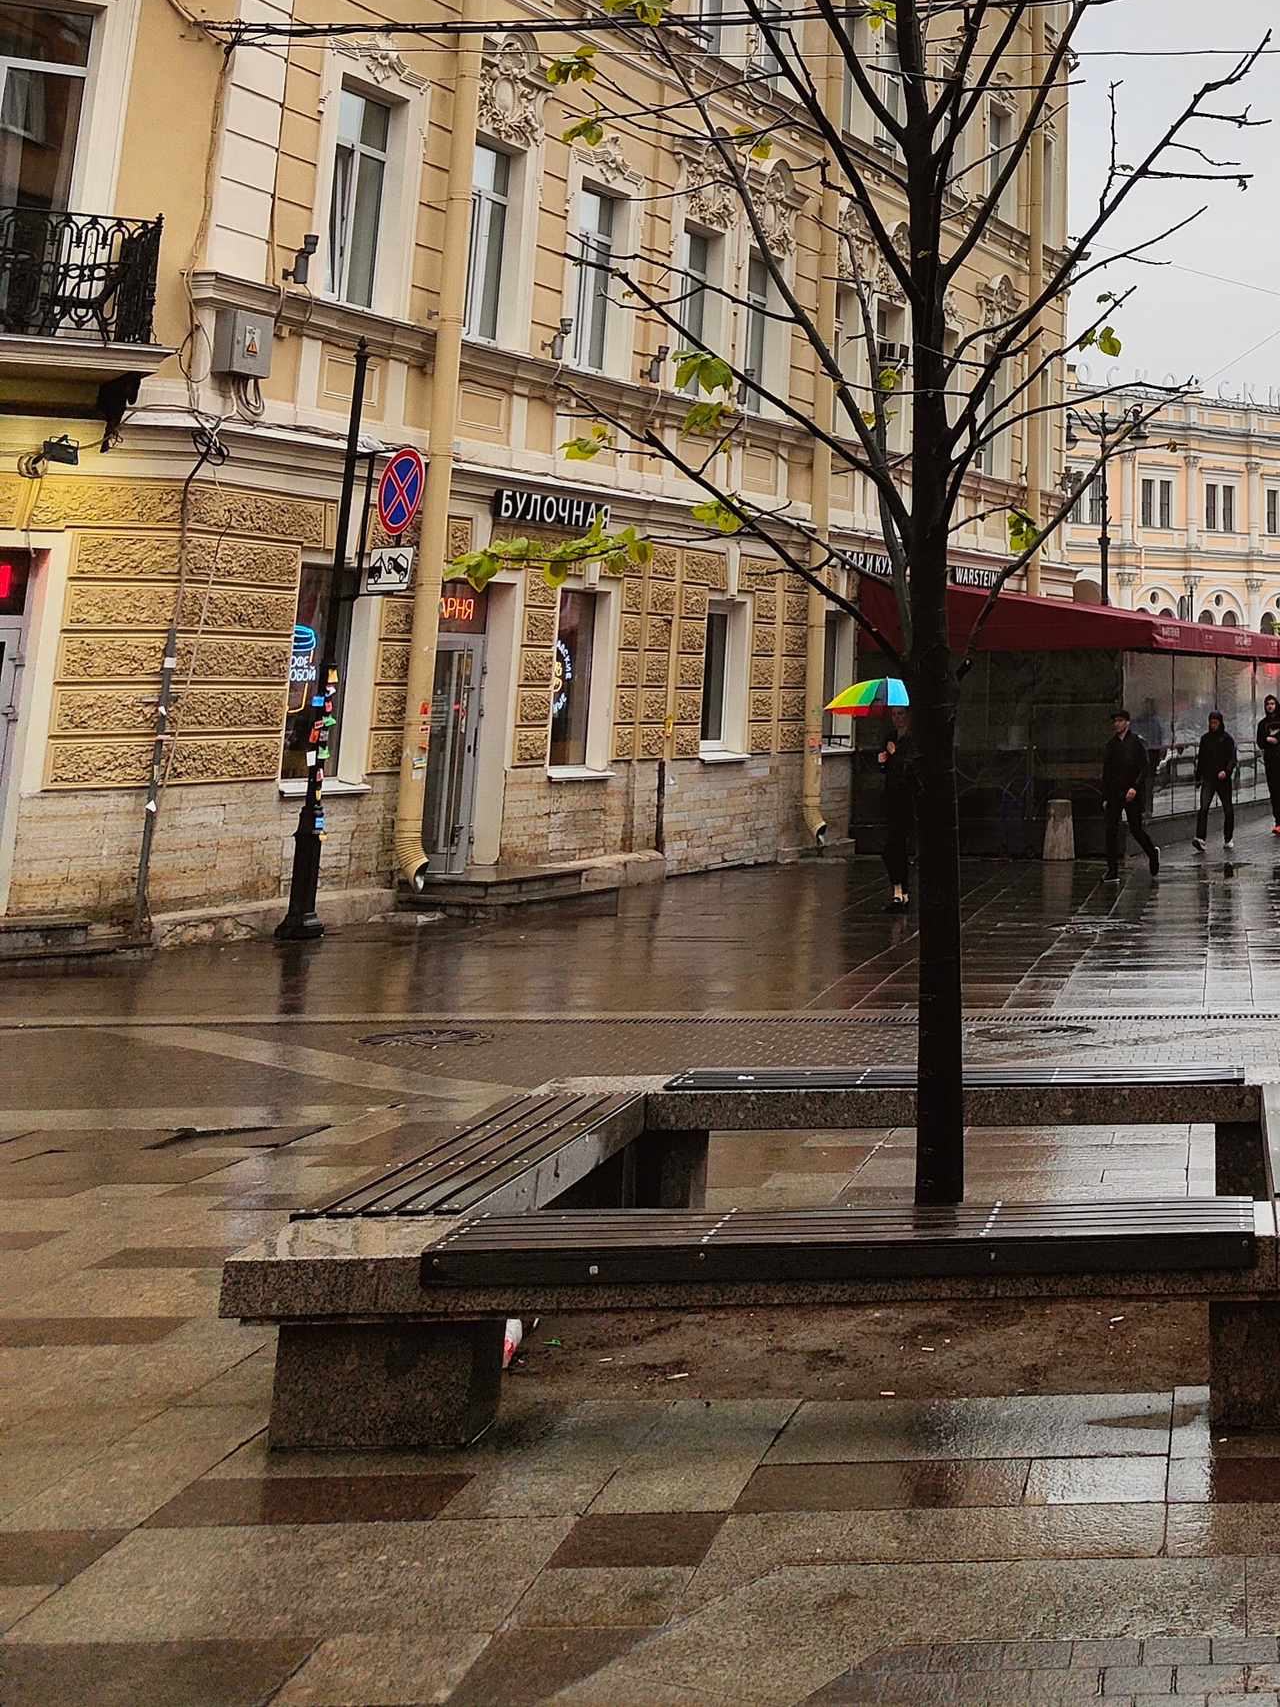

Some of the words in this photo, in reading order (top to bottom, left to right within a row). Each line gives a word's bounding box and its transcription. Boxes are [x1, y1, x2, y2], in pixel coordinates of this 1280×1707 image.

[500, 489, 611, 530] БУЛОЧНАЯ
[875, 555, 893, 575] КУХ
[955, 567, 998, 587] WARSTEIN
[440, 597, 474, 621] АРНЯ
[290, 655, 310, 668] ОФЕ
[290, 665, 317, 682] ОБОЙ
